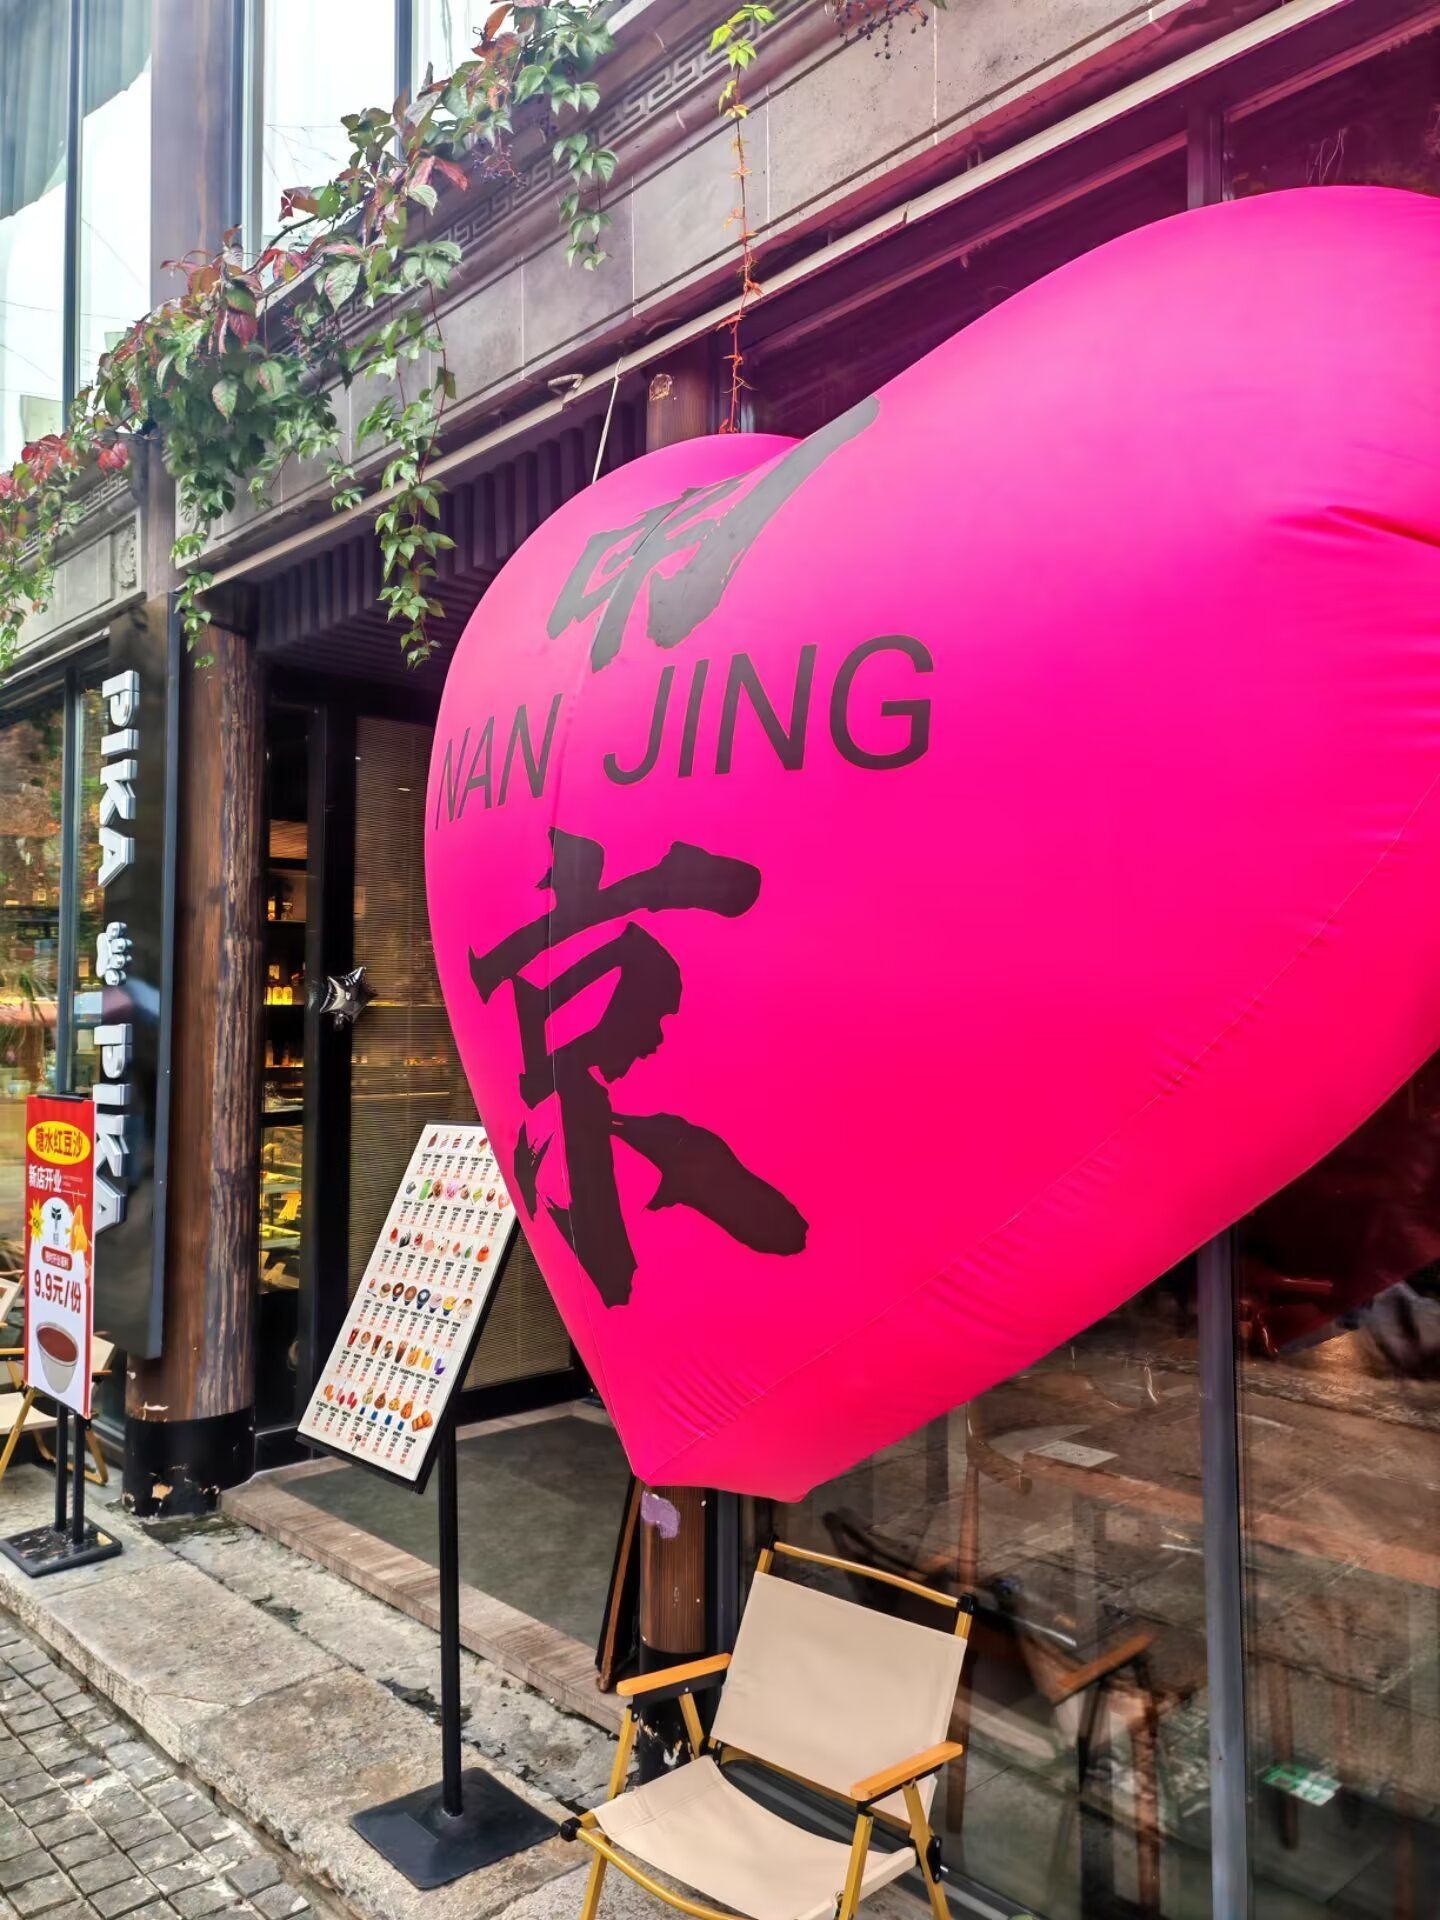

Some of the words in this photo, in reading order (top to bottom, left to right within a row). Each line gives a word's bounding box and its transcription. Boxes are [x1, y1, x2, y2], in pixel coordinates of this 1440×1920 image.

[98, 669, 140, 887] PIKA
[434, 693, 563, 829] NAN
[603, 634, 935, 785] JING
[93, 1023, 133, 1233] PIKA
[468, 827, 808, 1308] 京
[29, 1165, 62, 1193] 新店开业
[34, 1269, 81, 1313] 9.9元/份
